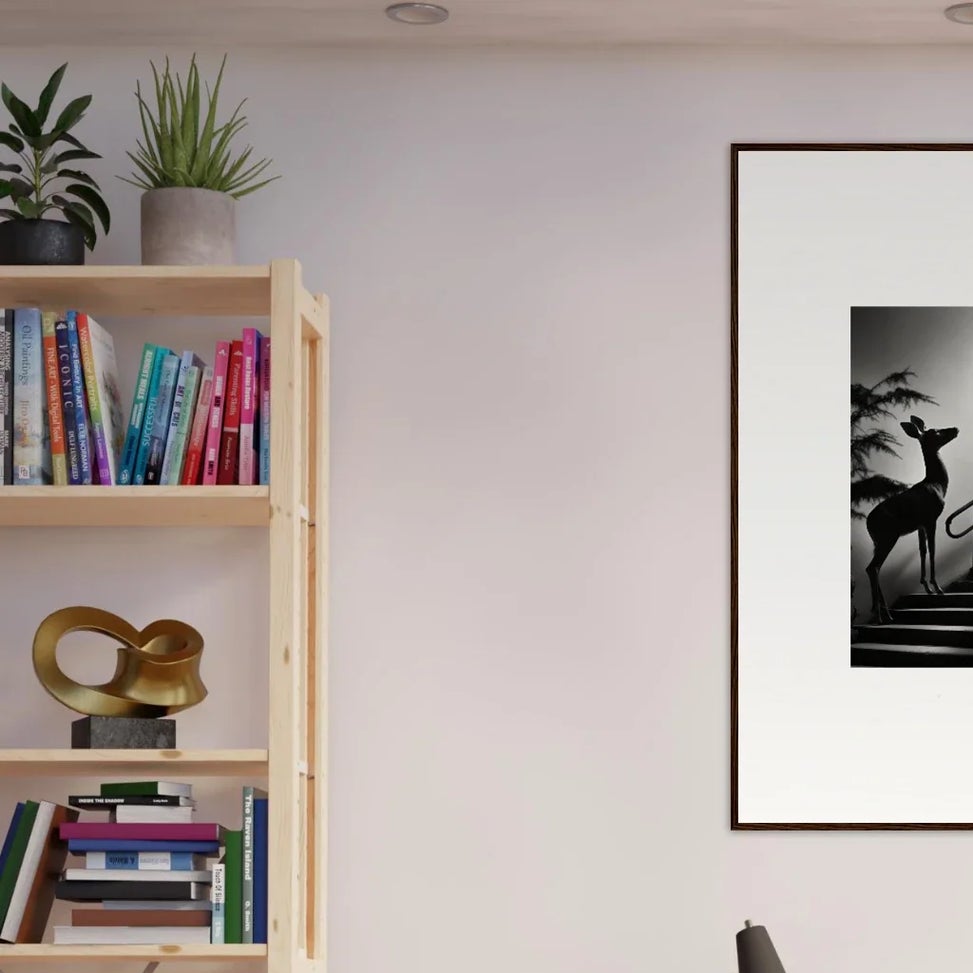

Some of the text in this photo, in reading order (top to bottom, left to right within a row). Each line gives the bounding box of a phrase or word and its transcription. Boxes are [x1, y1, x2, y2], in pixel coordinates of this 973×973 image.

[19, 325, 32, 385] Oil Paintings
[47, 347, 56, 365] FINE
[49, 365, 57, 379] ART
[79, 327, 98, 411] Watercolor Portraits
[50, 385, 59, 400] With
[229, 363, 240, 415] Parenting Skills
[49, 402, 61, 424] Digital
[53, 425, 62, 441] Tools
[79, 440, 88, 472] NORMAN
[215, 868, 223, 884] Touch
